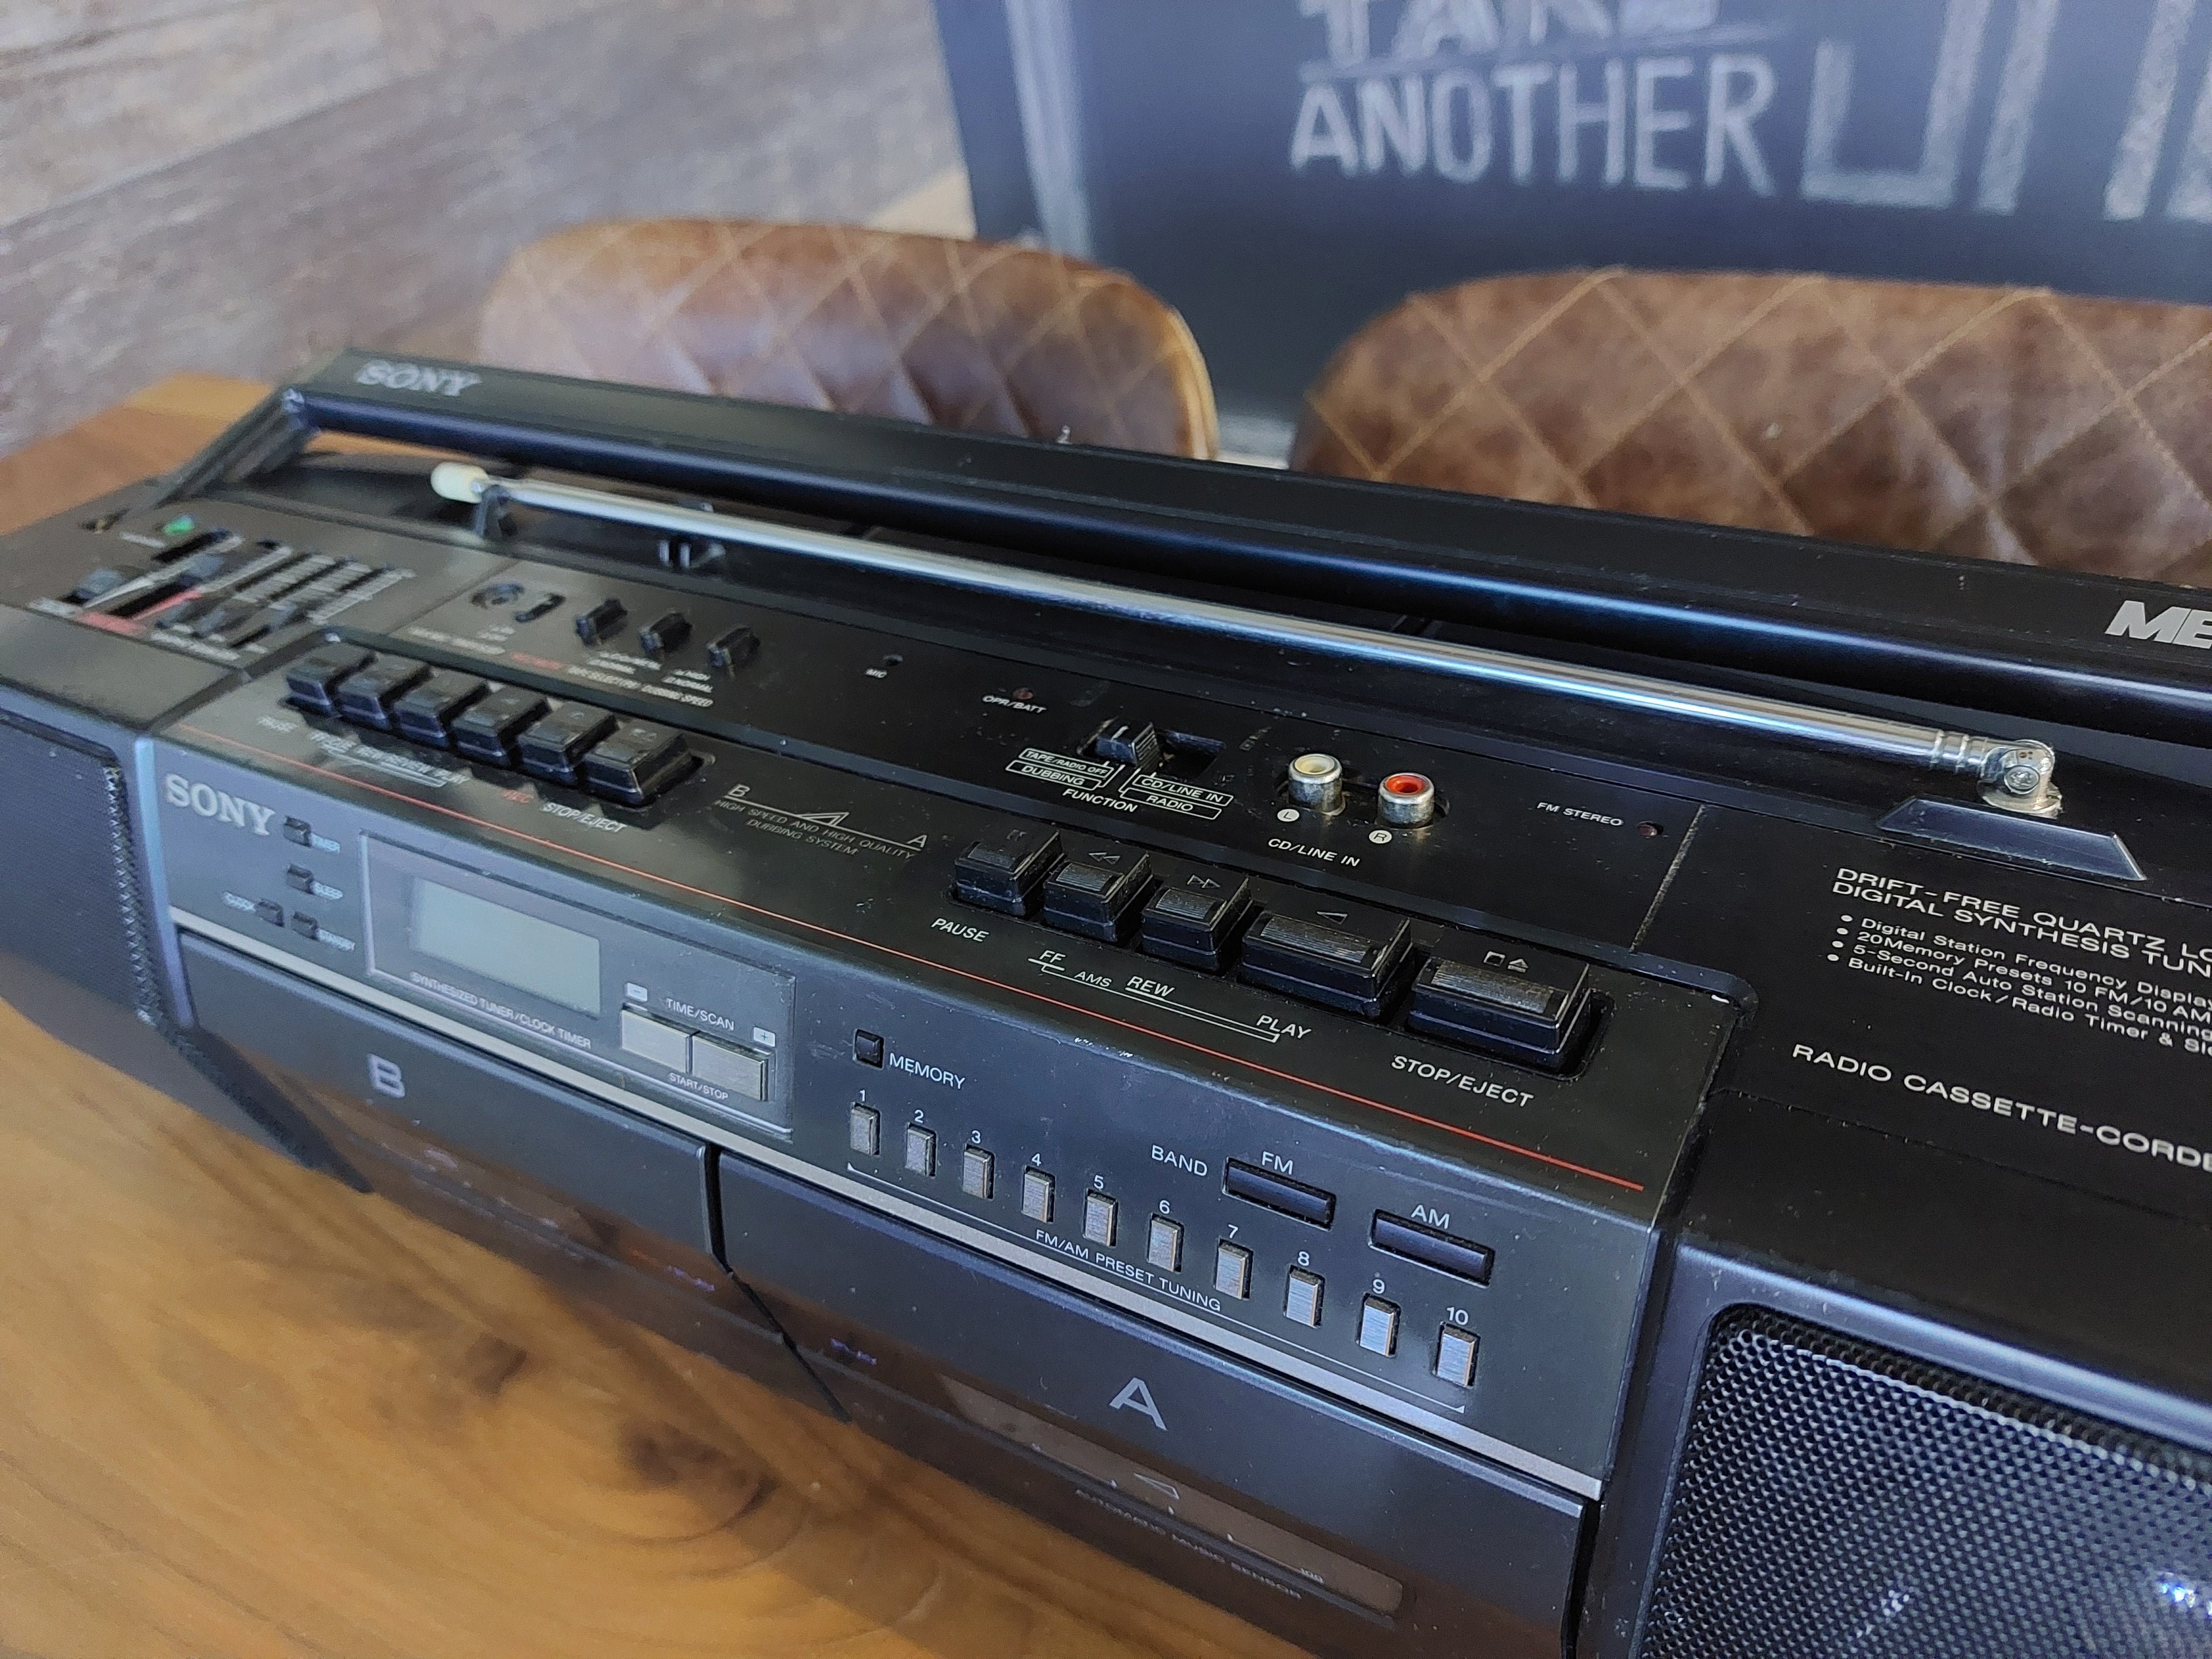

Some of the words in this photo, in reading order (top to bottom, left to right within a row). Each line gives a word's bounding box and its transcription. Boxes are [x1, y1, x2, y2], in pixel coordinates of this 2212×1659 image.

[1289, 53, 1777, 198] ANOTHER
[2104, 600, 2212, 649] ME
[865, 668, 888, 679] MIC
[982, 694, 1048, 714] OPR/BATT
[1021, 766, 1085, 786] DUBBING
[1025, 751, 1086, 771] TAPE/RADIO
[1087, 767, 1108, 775] OFF
[164, 773, 275, 836] SONY
[1062, 788, 1138, 813] FUNCTION
[1141, 778, 1202, 798] CD/LINE
[1205, 792, 1225, 804] IN
[1145, 794, 1194, 812] RADIO
[541, 802, 628, 833] STOP/EJECT
[714, 799, 746, 812] HIGH
[748, 808, 788, 824] SPEED
[790, 819, 820, 833] AND
[822, 828, 856, 843] HIGH
[859, 839, 915, 860] QUALITY
[728, 783, 751, 798] B
[907, 834, 929, 848] A
[1536, 801, 1559, 813] FM
[1563, 808, 1624, 827] STEREO
[747, 819, 803, 840] DUBBING
[806, 835, 858, 855] SYSTEM
[1268, 838, 1338, 862] CD/LINE
[1340, 855, 1361, 867] IN
[931, 918, 990, 942] PAUSE
[1832, 881, 1945, 917] DIGITAL
[1953, 909, 2130, 959] SYNTHESIS
[2141, 950, 2212, 978] TUN
[2033, 912, 2166, 952] QUARTZ
[1861, 918, 1925, 942] Digital
[1934, 934, 2006, 961] Station
[2015, 953, 2127, 990] Frequency
[1039, 949, 1066, 964] FF
[1074, 970, 1113, 988] AMS
[1126, 975, 1176, 998] REW
[1256, 1014, 1312, 1040] PLAY
[1853, 944, 1954, 977] 5-Second
[1963, 970, 2012, 991] Auto
[2021, 984, 2099, 1013] Station
[1974, 958, 2053, 986] Presets
[2064, 980, 2087, 994] 10
[2094, 986, 2167, 1013] FM/10
[2172, 1005, 2211, 1025] AM
[410, 971, 479, 1006] SYNTHESIZED
[556, 1028, 592, 1050] TIMER
[665, 997, 736, 1032] TIME/SCAN
[1848, 958, 1923, 984] Built-In
[1932, 977, 2075, 1022] Clock/Radio
[2085, 1014, 2149, 1040] Timer
[2158, 1032, 2173, 1047] &
[368, 1053, 406, 1099] B
[889, 1052, 965, 1090] MEMORY
[1391, 1055, 1535, 1107] STOP/EJECT
[1791, 1043, 1892, 1082] RADIO
[668, 1071, 729, 1101] START/STOP
[1151, 1144, 1209, 1177] BAND
[1260, 1150, 1294, 1176] FM
[858, 1089, 866, 1101] 1
[914, 1109, 925, 1124] 2
[971, 1130, 982, 1145] 3
[1031, 1153, 1042, 1167] 4
[1093, 1175, 1104, 1190] 5
[1158, 1199, 1171, 1215] 6
[1226, 1224, 1239, 1239] 7
[1297, 1251, 1310, 1267] 8
[1372, 1278, 1385, 1296] 9
[1445, 1306, 1469, 1326] 10
[1410, 1203, 1451, 1230] AM
[1035, 1228, 1089, 1260] FM/AM
[1095, 1251, 1155, 1285] PRESET
[1158, 1276, 1221, 1312] TUNING
[1108, 1376, 1168, 1431] A
